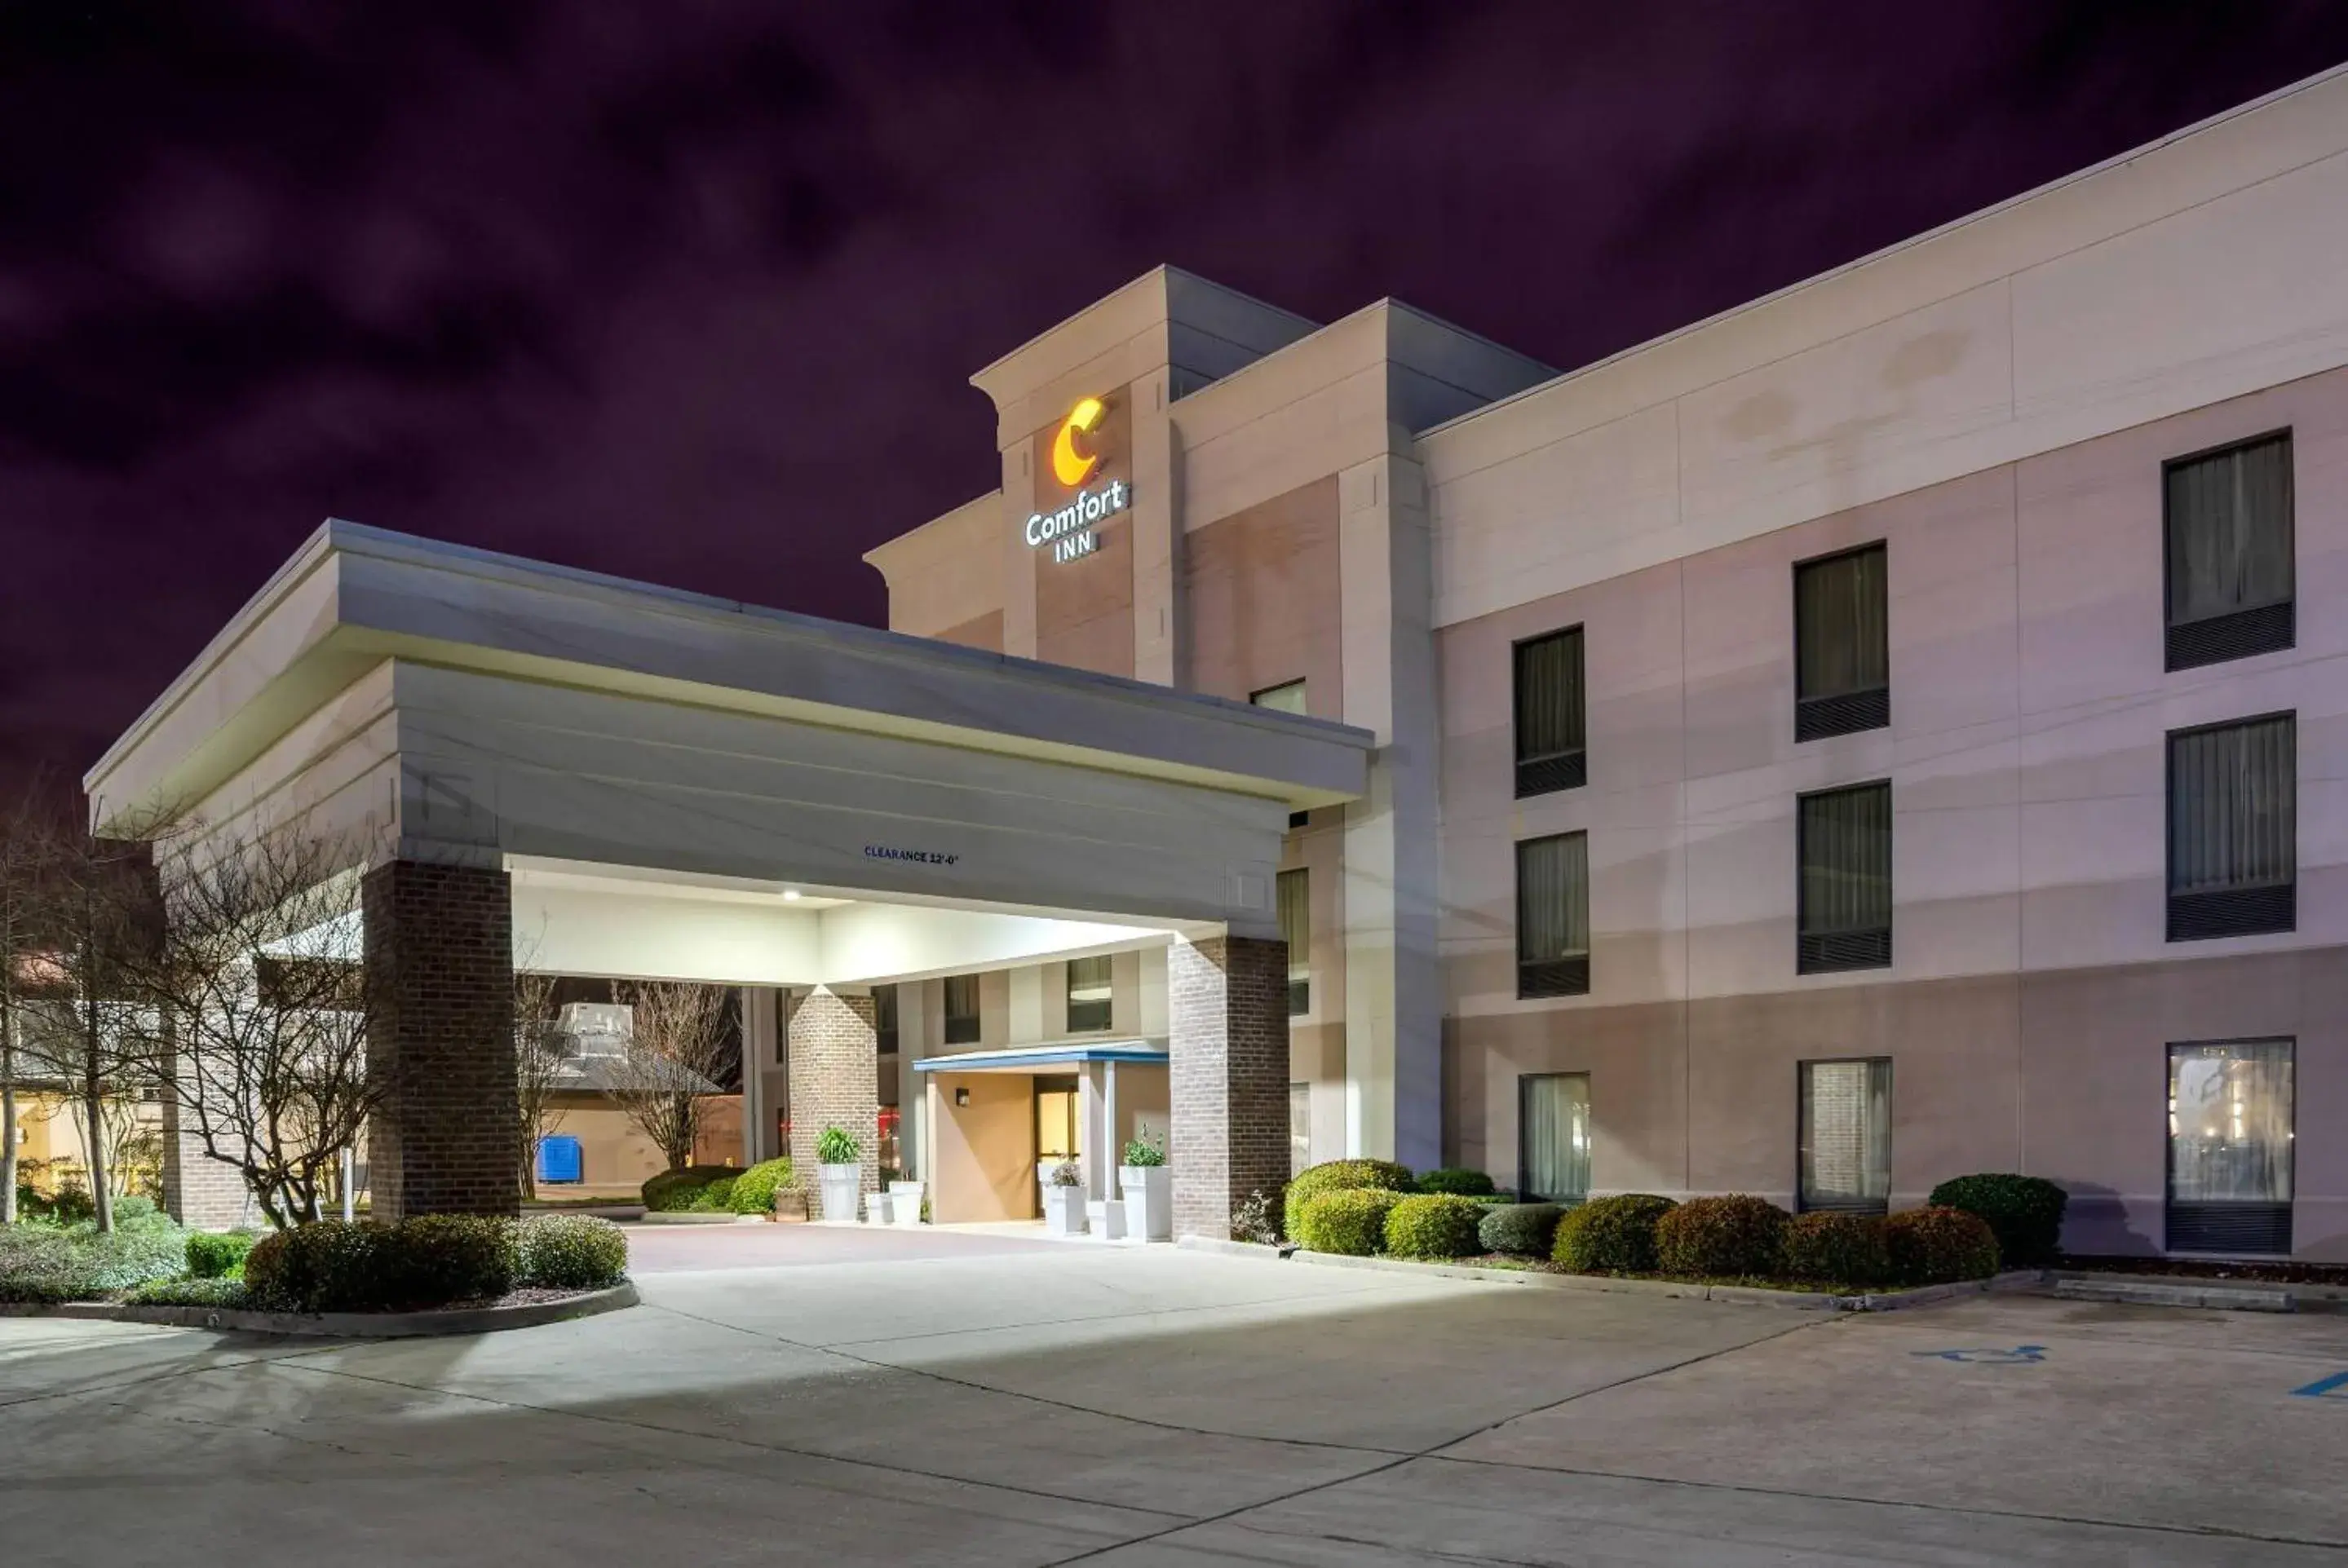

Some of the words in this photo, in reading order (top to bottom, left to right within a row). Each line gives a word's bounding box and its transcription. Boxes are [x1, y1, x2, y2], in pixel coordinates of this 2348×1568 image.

[1025, 479, 1123, 546] Comfort
[1055, 530, 1092, 563] INN
[864, 846, 927, 863] CLEARANCE
